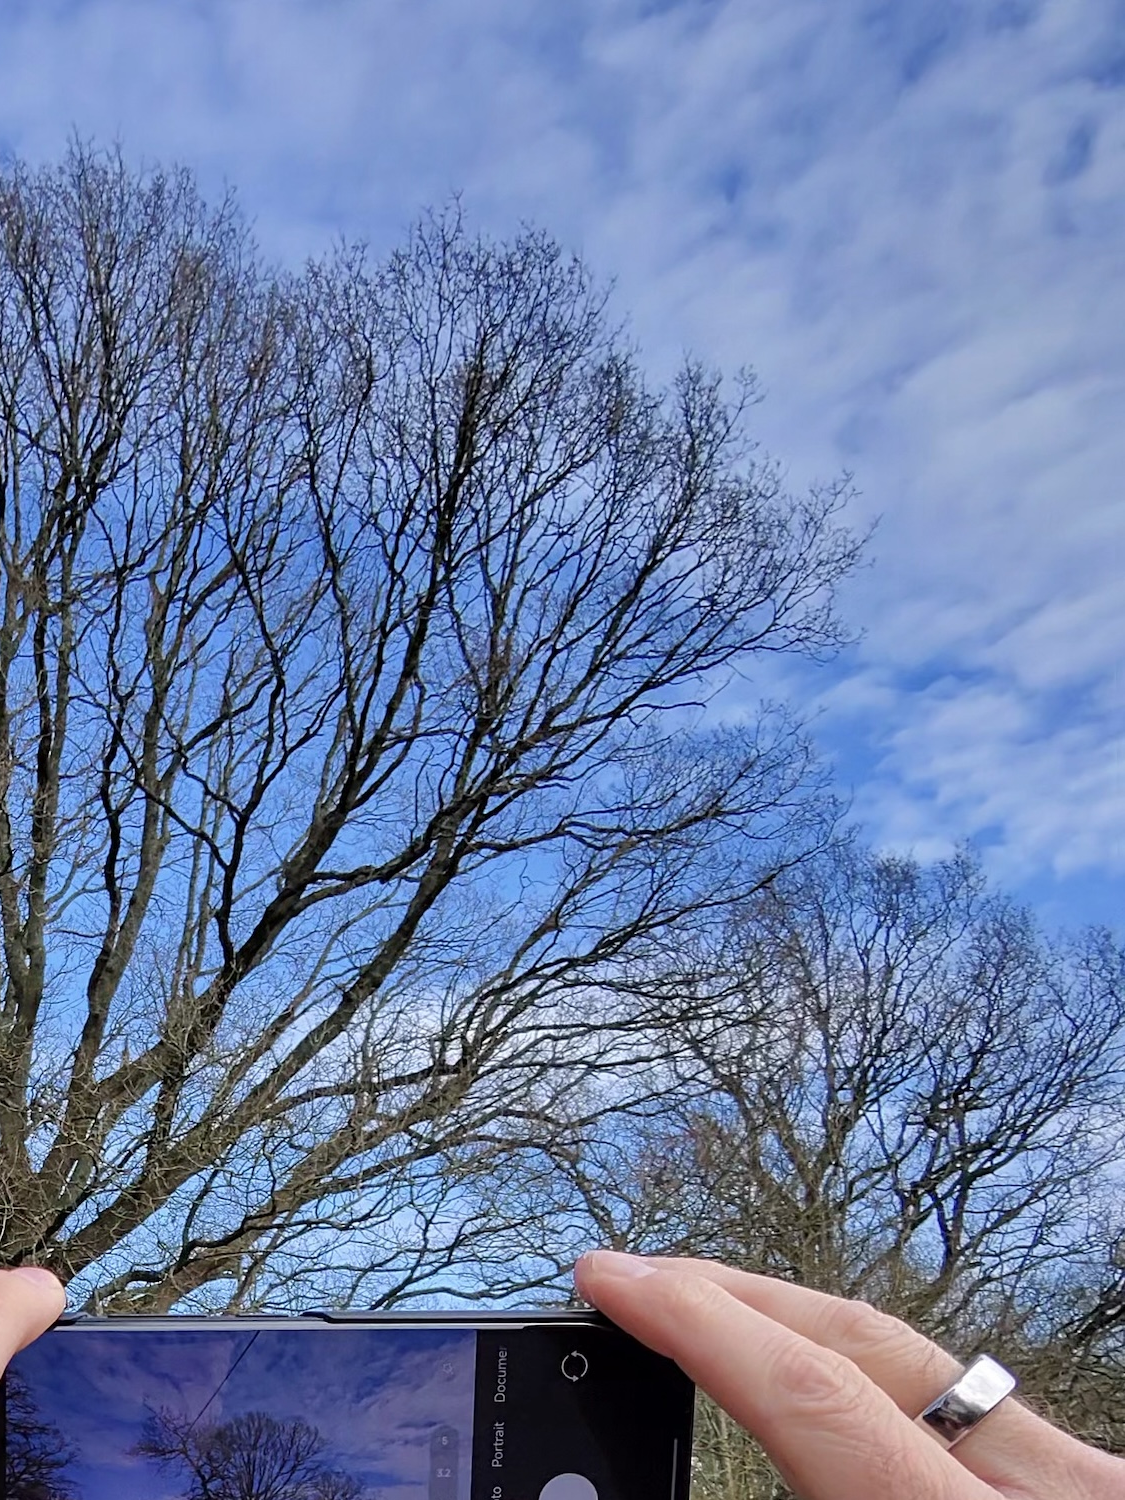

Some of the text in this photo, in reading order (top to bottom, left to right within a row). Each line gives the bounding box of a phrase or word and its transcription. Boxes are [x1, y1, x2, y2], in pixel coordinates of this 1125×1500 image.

[441, 1436, 448, 1446] 5
[491, 1421, 505, 1468] Portrait
[436, 1468, 451, 1478] 3.2
